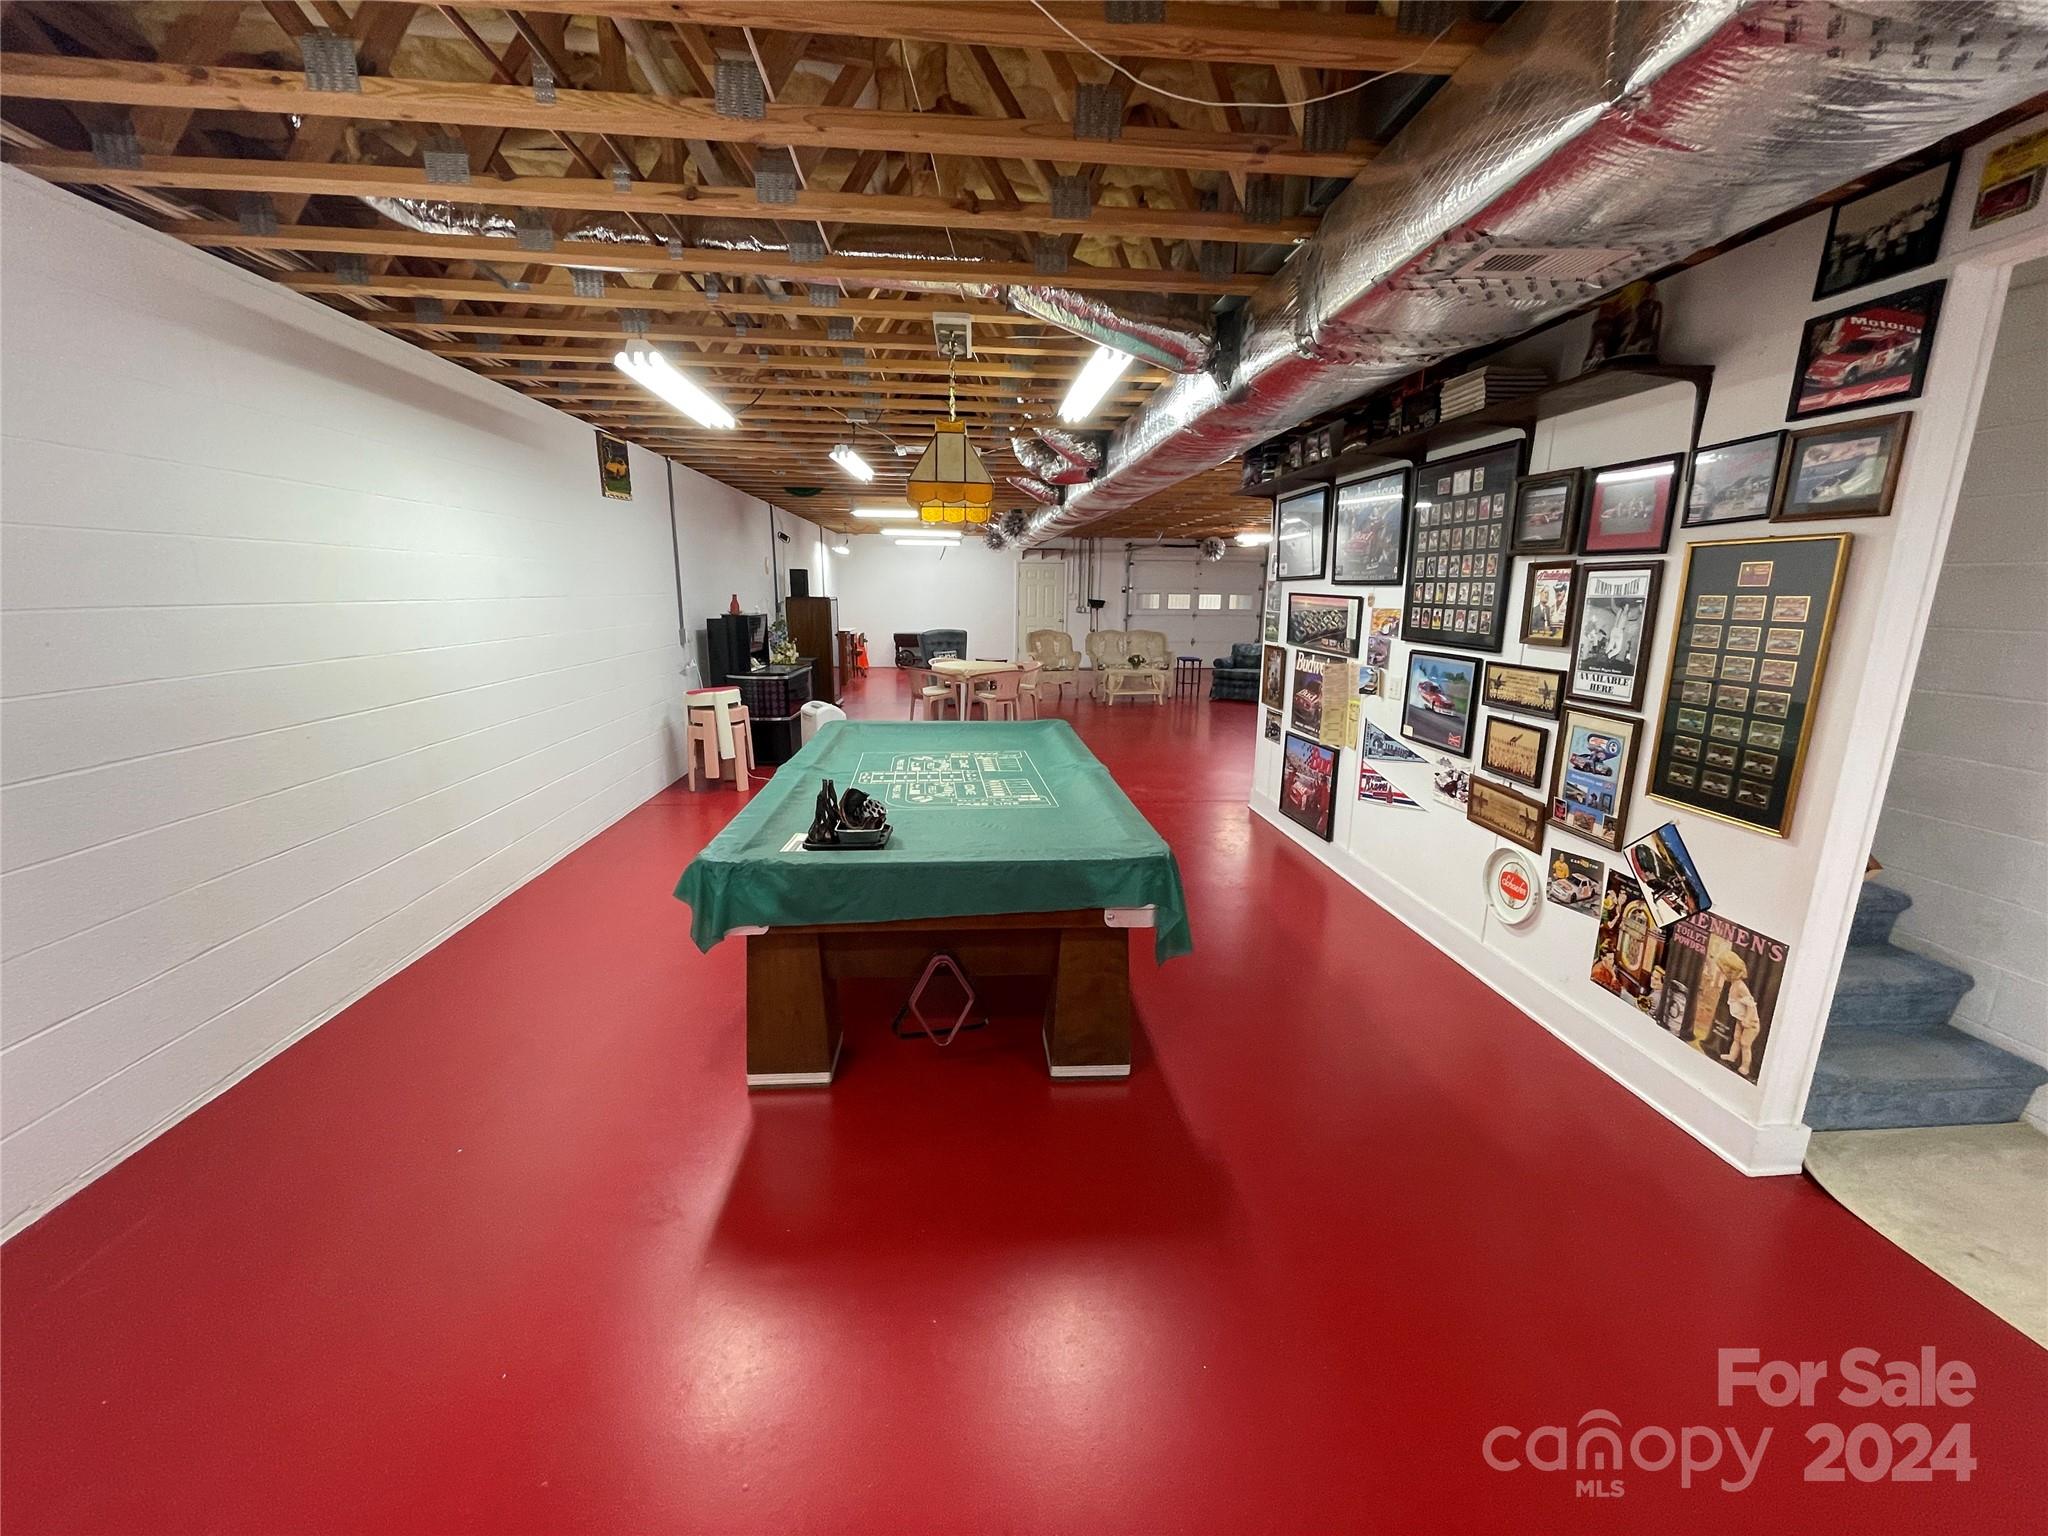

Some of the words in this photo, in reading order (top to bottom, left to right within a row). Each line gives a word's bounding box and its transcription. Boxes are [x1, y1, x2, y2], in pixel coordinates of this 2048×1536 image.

[1296, 651, 1330, 677] Budwe
[1580, 671, 1629, 687] AVAILABLE
[1589, 682, 1613, 695] HERE
[1673, 932, 1707, 956] POWDER
